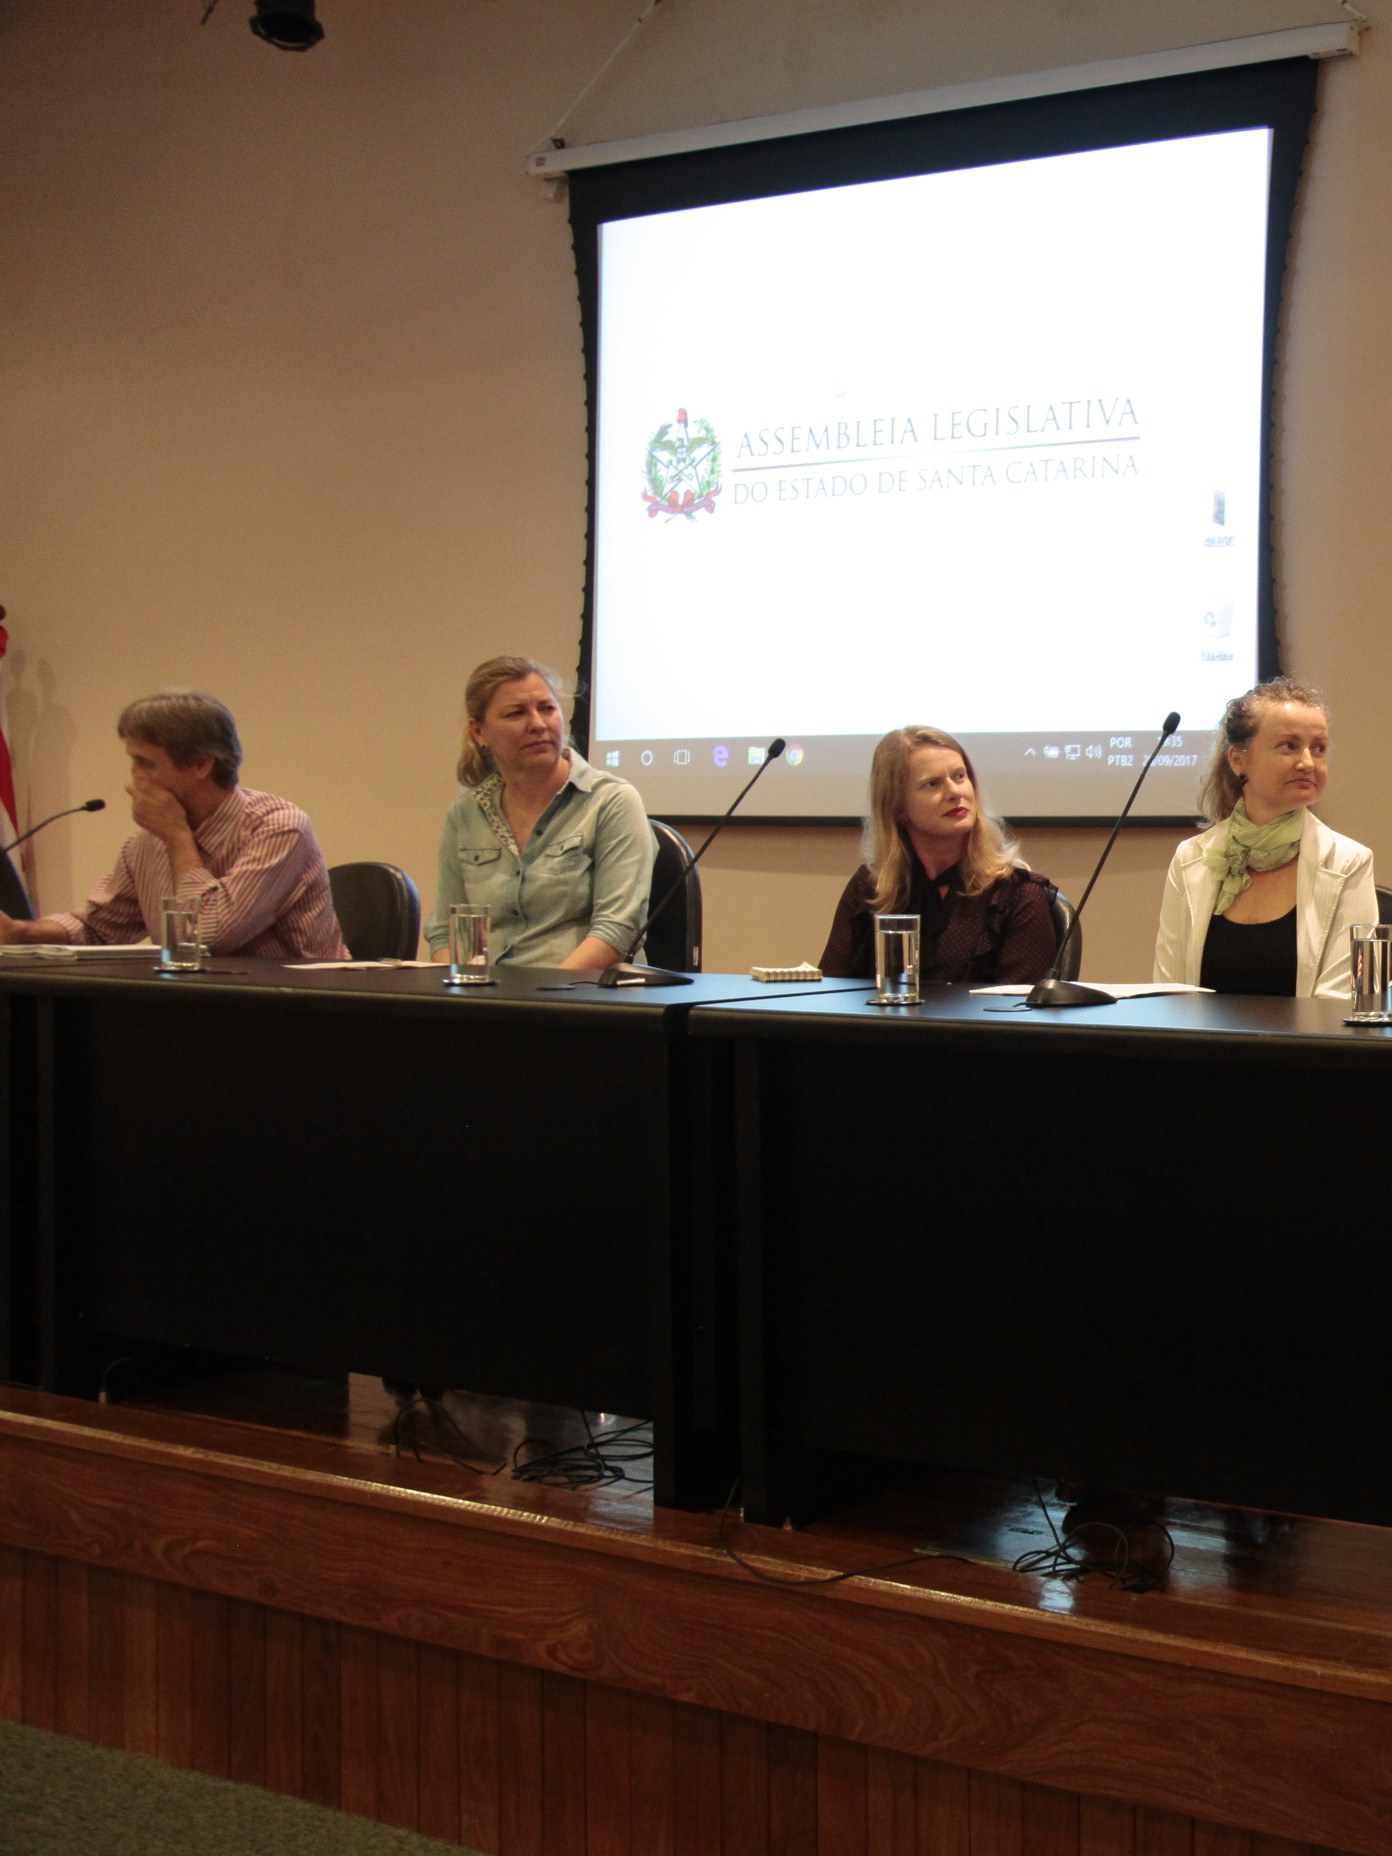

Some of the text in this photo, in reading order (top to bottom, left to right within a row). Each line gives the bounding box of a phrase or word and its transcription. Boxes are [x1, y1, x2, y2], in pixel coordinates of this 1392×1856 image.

[736, 396, 1140, 459] ASSEMBLEIA LEGISLATIVA
[733, 453, 1140, 505] DO ESTADO DE SANTA CATARINA
[1110, 737, 1133, 749] POR
[1107, 754, 1199, 767] PTB2 2/09/2017
